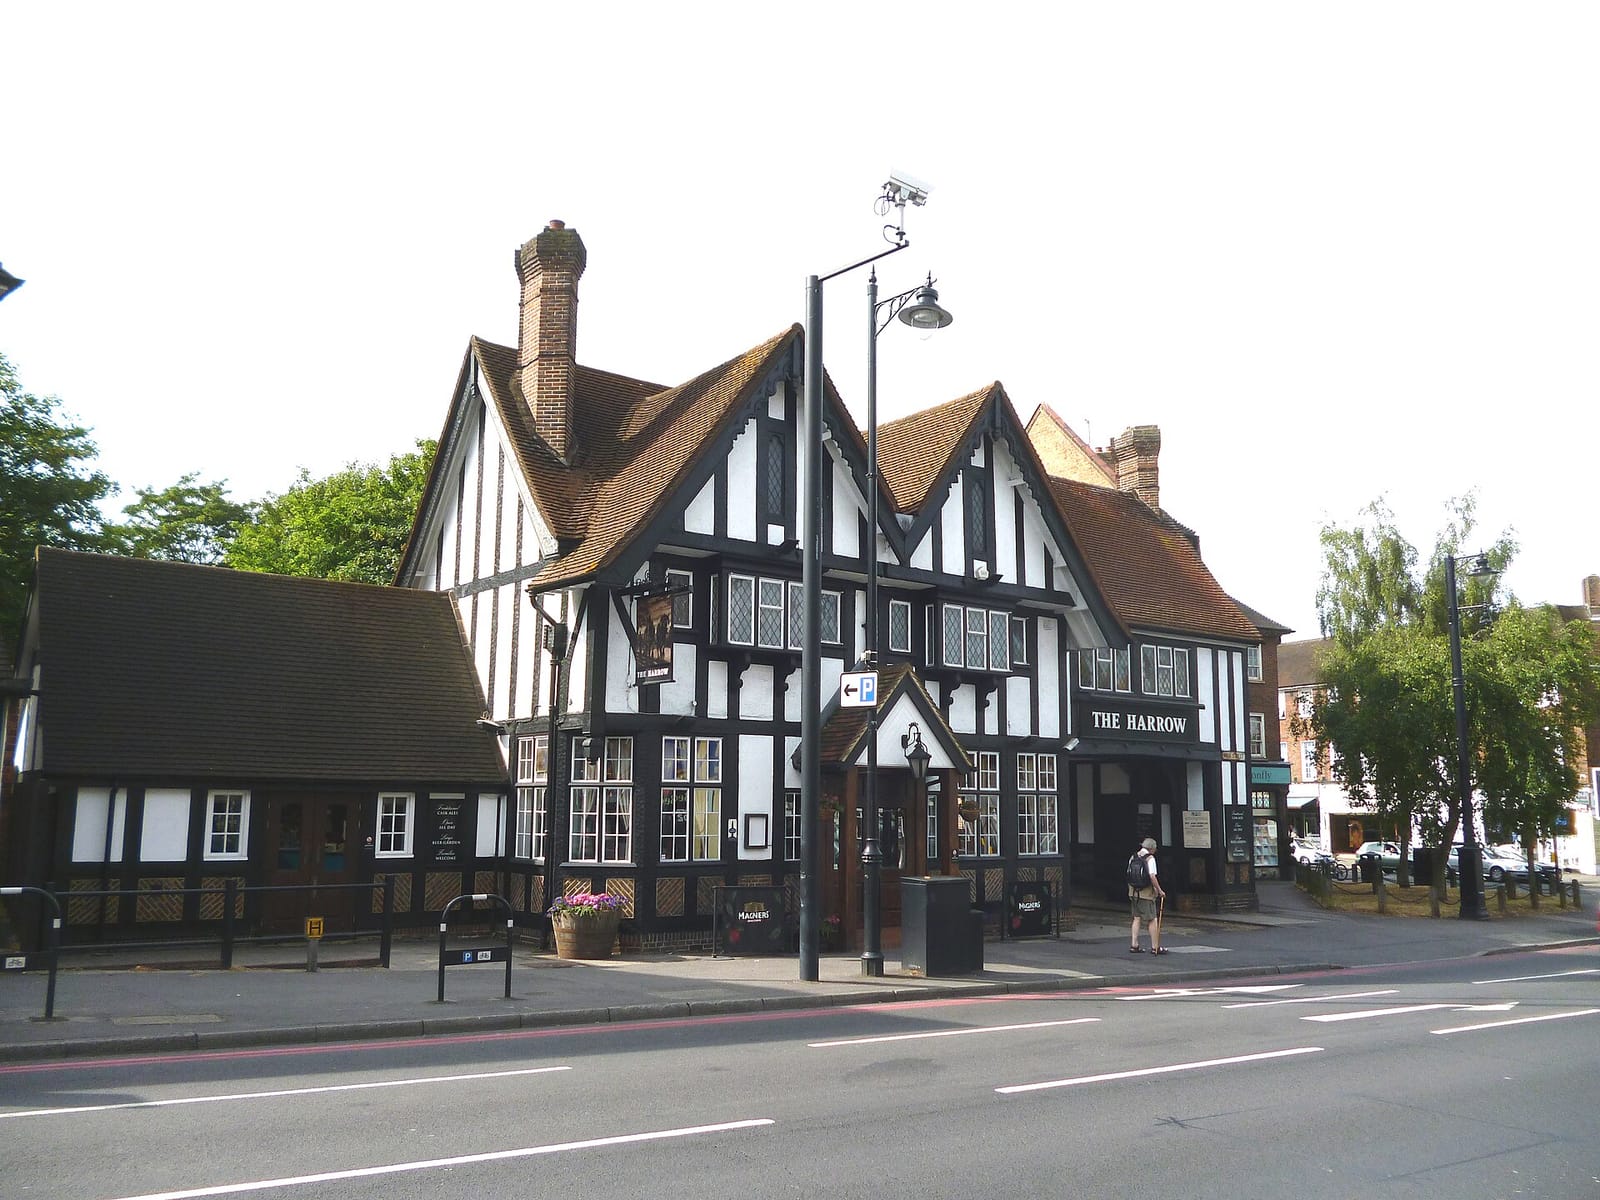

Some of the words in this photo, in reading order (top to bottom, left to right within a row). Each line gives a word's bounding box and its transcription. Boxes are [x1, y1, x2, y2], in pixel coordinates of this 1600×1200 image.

[637, 670, 647, 678] THE
[647, 667, 669, 677] HARROW
[862, 678, 873, 701] P
[1092, 711, 1120, 729] THE
[1126, 714, 1187, 734] HARROW
[738, 911, 769, 920] MAGNERS
[310, 920, 321, 936] H
